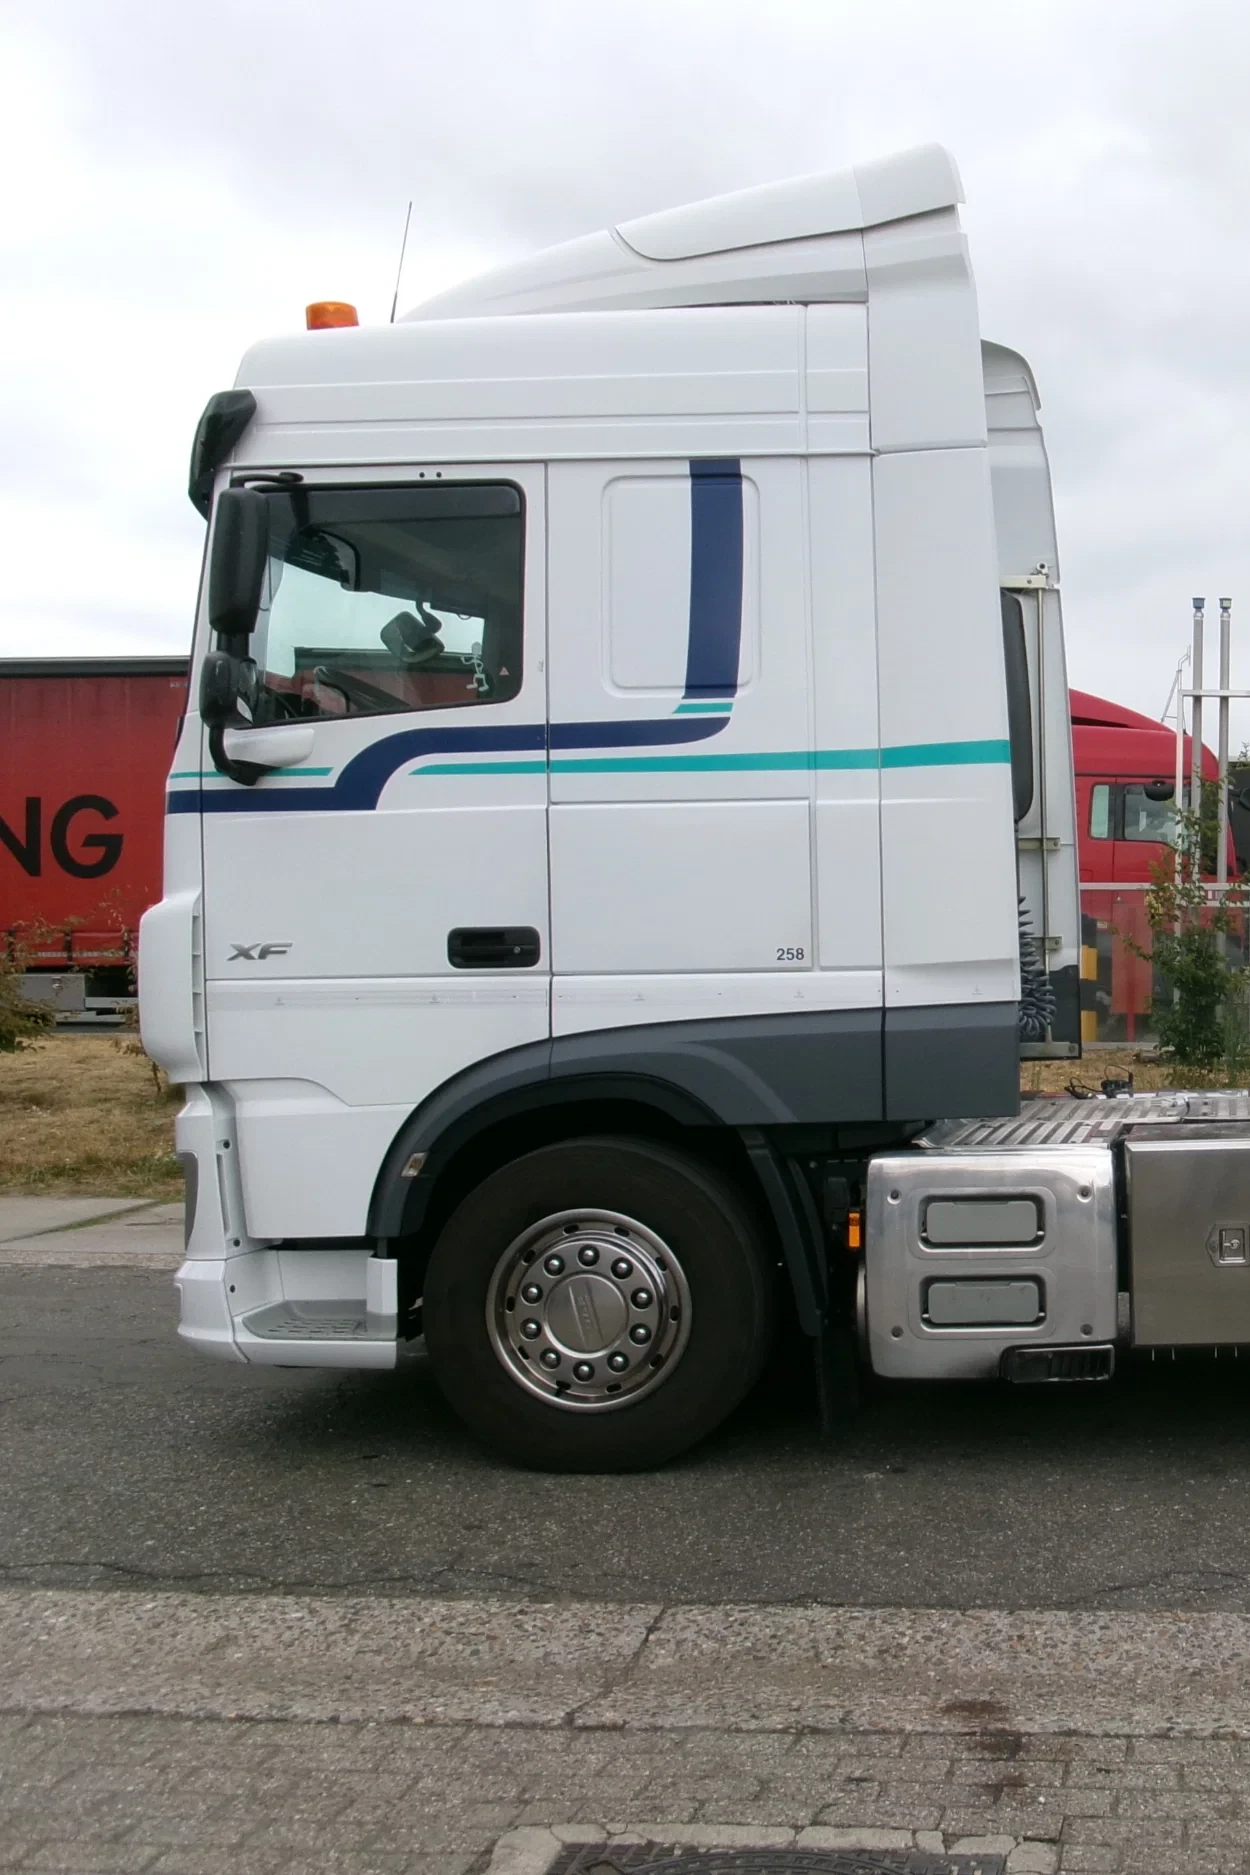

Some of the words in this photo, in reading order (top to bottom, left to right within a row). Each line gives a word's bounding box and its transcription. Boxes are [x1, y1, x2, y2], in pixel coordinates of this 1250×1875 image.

[0, 794, 124, 879] NG
[226, 942, 294, 961] XF
[776, 947, 805, 961] 258
